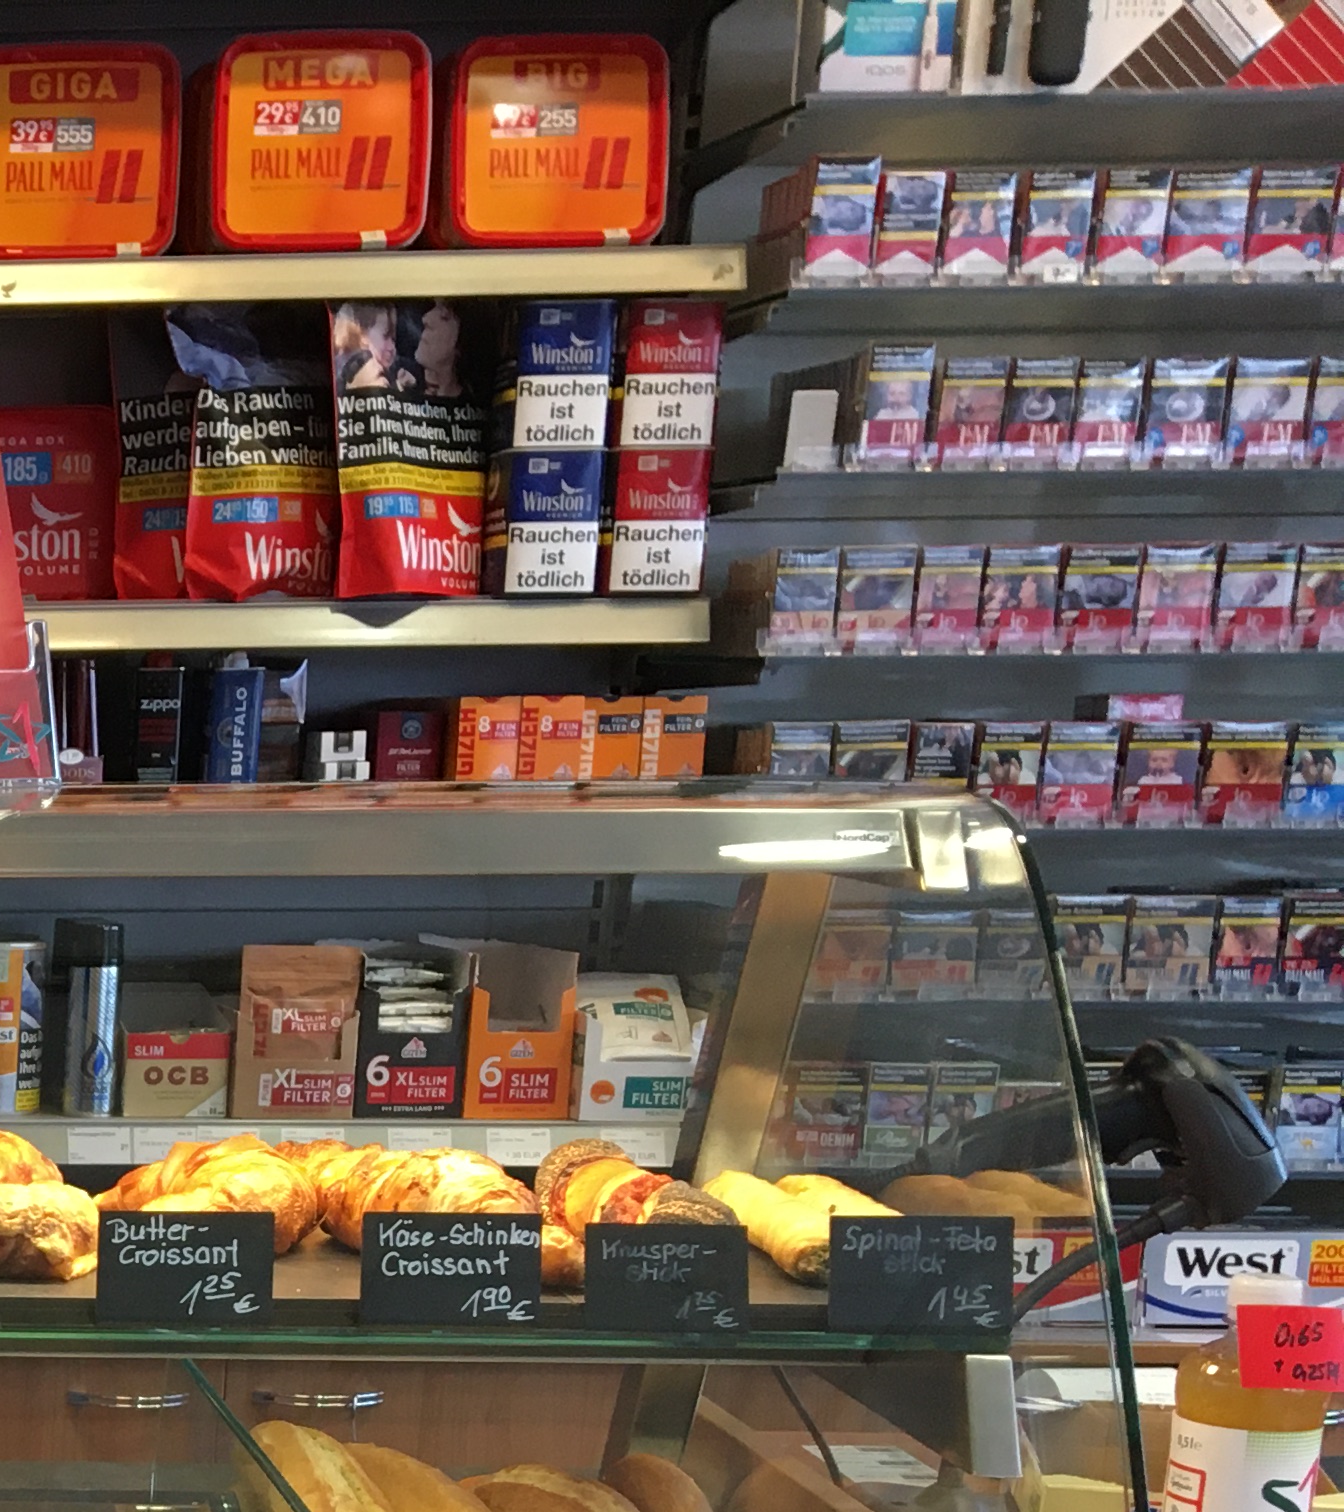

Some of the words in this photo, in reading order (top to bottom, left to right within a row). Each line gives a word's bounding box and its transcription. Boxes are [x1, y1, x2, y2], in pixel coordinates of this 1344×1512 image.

[266, 57, 374, 88] MEGA
[525, 62, 589, 85] BIG
[30, 71, 117, 100] GIGA
[250, 147, 291, 180] PALL
[296, 145, 341, 178] MALL
[489, 147, 530, 179] PALL
[535, 147, 580, 178] MALL
[6, 161, 45, 192] PALL
[50, 159, 93, 191] MALL
[531, 343, 593, 365] Winston
[639, 342, 703, 364] Winston
[519, 380, 607, 397] Rauchen
[626, 379, 716, 396] Rauchen
[234, 388, 313, 414] Rauchen
[338, 396, 387, 415] Wenn
[387, 395, 402, 412] Sie
[403, 400, 451, 422] rauchen,
[550, 402, 575, 419] ist
[657, 401, 682, 418] ist
[196, 416, 291, 445] aufgeben
[338, 419, 365, 438] Sie
[370, 416, 403, 434] Ihren
[404, 419, 450, 443] Kindern,
[525, 424, 595, 442] tödlich
[632, 423, 702, 441] tödlich
[195, 445, 266, 467] Lieben
[338, 437, 403, 460] Familie,
[402, 442, 429, 460] Ihren
[523, 490, 584, 512] Winston
[629, 488, 691, 510] Winston
[511, 527, 597, 544] Rauchen
[615, 525, 703, 542] Rauchen
[541, 549, 565, 565] ist
[646, 548, 671, 564] ist
[517, 571, 585, 588] tödlich
[622, 568, 690, 586] tödlich
[230, 686, 248, 777] BUFFALO
[478, 716, 491, 732] 8
[540, 715, 553, 732] 8
[519, 707, 539, 775] GIZEH
[579, 710, 597, 778] GIZEH
[641, 709, 661, 777] GIZEH
[134, 1045, 164, 1056] SLIM
[143, 1066, 209, 1085] OCB
[273, 1068, 303, 1089] XL
[366, 1055, 390, 1086] 6
[396, 1072, 418, 1086] XL
[418, 1076, 447, 1086] SLIM
[480, 1056, 501, 1087] 6
[511, 1073, 550, 1087] SLIM
[408, 1087, 446, 1098] FILTER
[509, 1088, 548, 1098] FILTER
[652, 1080, 681, 1090] SLIM
[283, 1090, 330, 1103] FILTER
[632, 1092, 679, 1106] FILTER
[109, 1217, 209, 1244] Butter-
[118, 1241, 240, 1267] Croissant
[381, 1249, 511, 1276] Croissant
[601, 1239, 717, 1272] Knusper-
[1176, 1247, 1286, 1278] West
